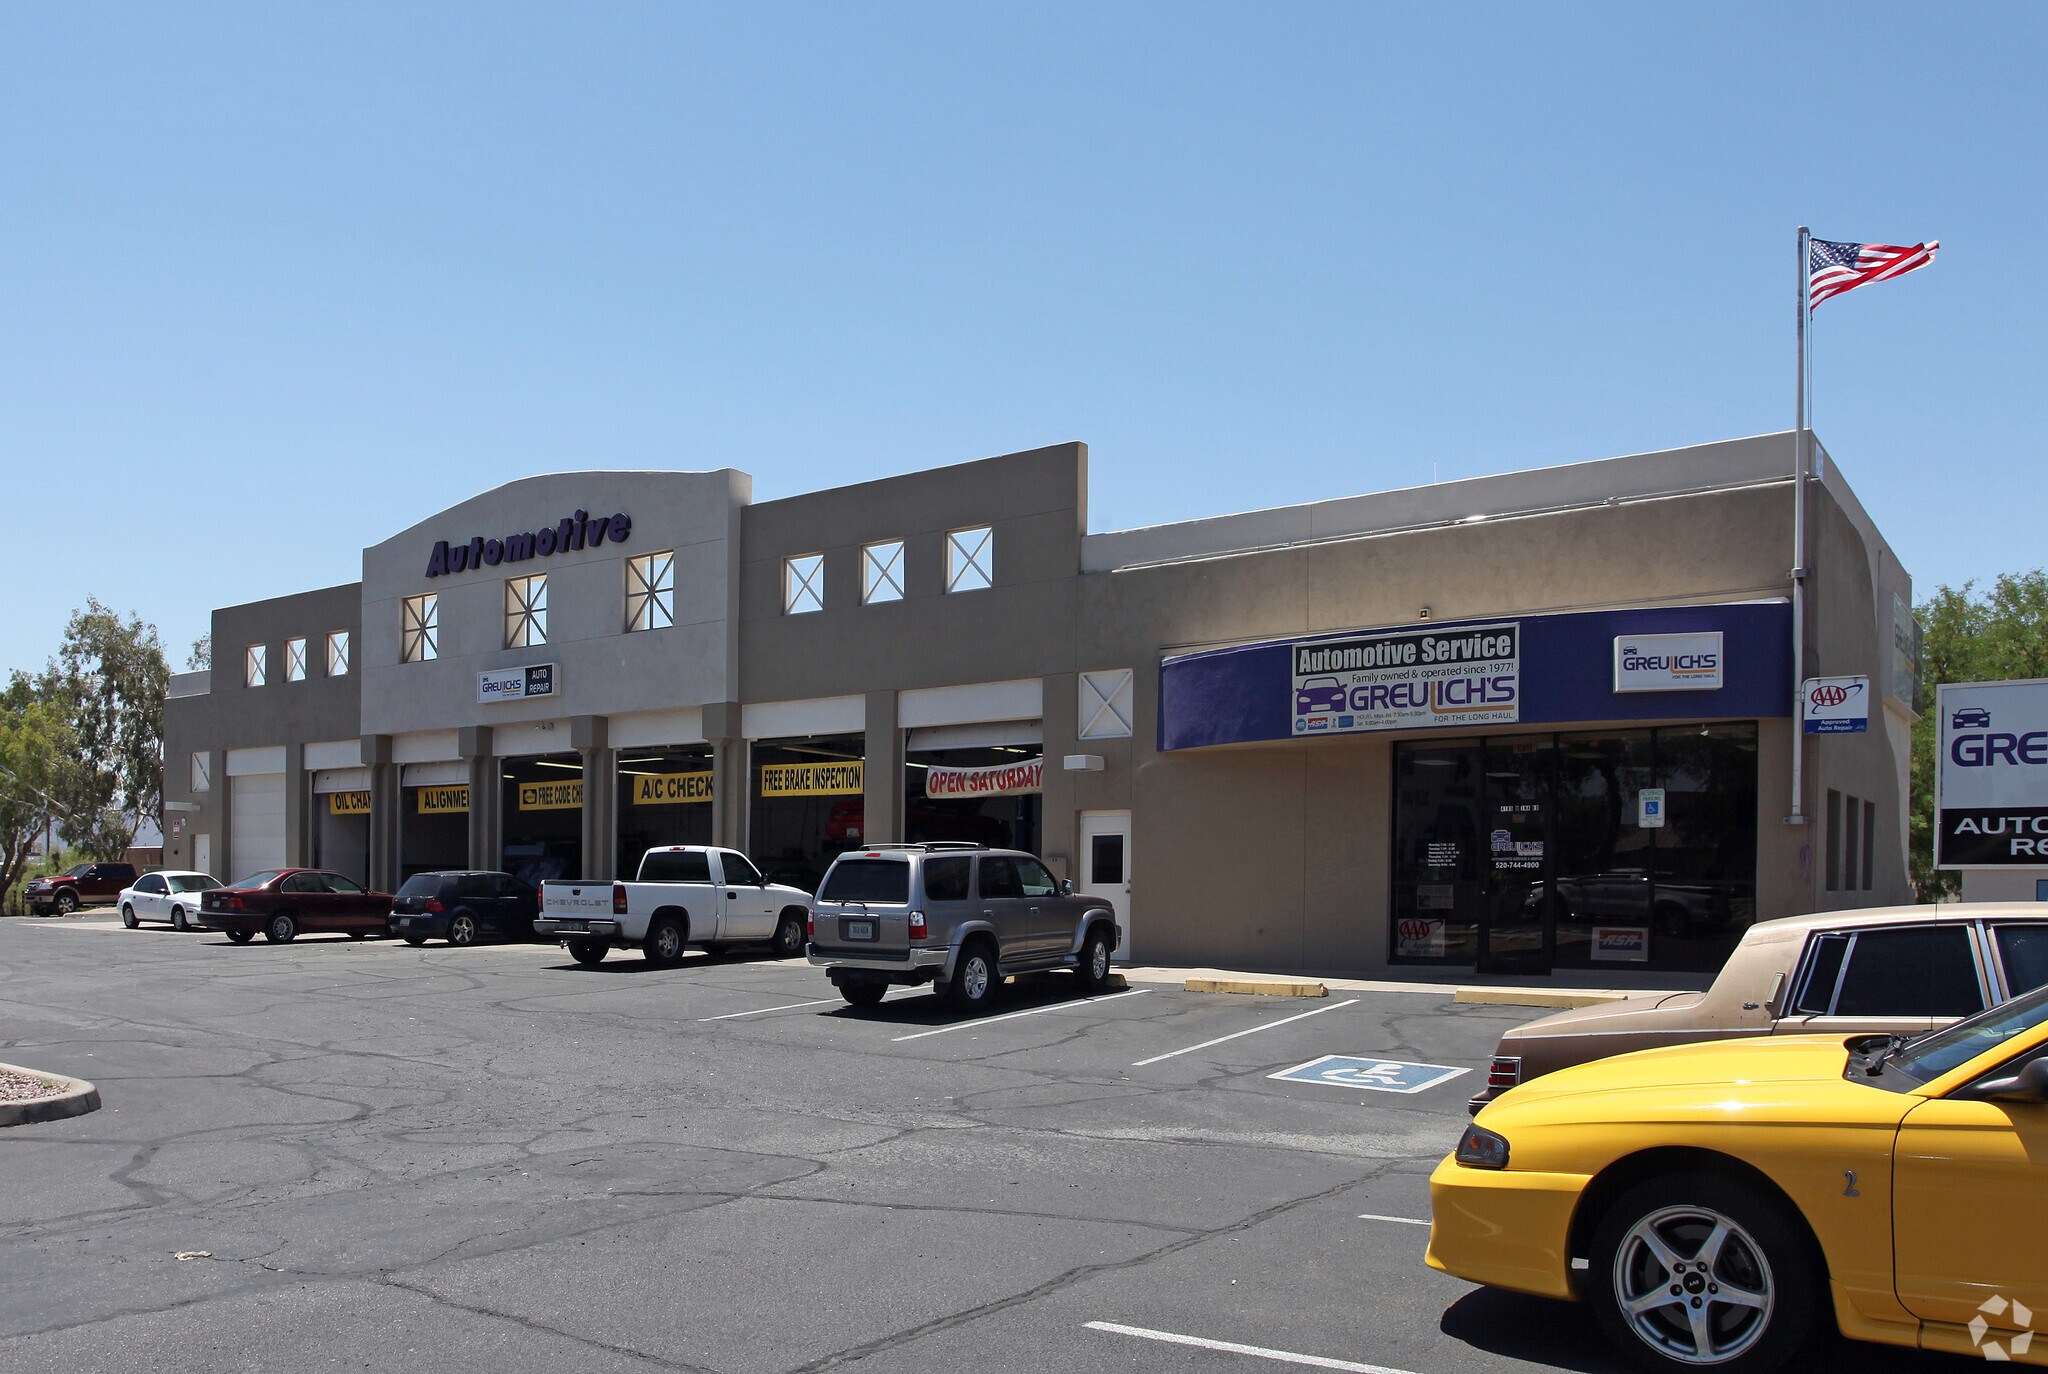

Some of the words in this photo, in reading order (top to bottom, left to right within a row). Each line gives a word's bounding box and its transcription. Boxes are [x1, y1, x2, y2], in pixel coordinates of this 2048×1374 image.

[425, 508, 632, 578] Automotive
[1299, 641, 1416, 673] Automotive
[1421, 634, 1511, 663] Service
[532, 669, 548, 680] AUTO
[1352, 672, 1379, 684] Family
[1381, 670, 1410, 681] owned
[1412, 669, 1419, 679] &
[1421, 666, 1462, 679] operated
[1464, 664, 1487, 675] since
[1490, 662, 1514, 673] 1977!
[529, 682, 550, 693] REPAIR
[1350, 676, 1516, 714] GREULICH'S
[1813, 685, 1845, 706] AAA
[1952, 732, 2047, 766] GRE
[641, 778, 664, 799] A/C
[667, 776, 713, 798] CHECK
[764, 769, 783, 790] FREE
[785, 768, 811, 790] BRAKE
[812, 766, 861, 789] INSPECTION
[929, 771, 967, 793] OPEN
[969, 764, 1043, 791] SATURDAY
[335, 792, 350, 810] OIL
[538, 786, 554, 805] FREE
[555, 785, 571, 804] CODE
[546, 899, 609, 907] CHEVROLET
